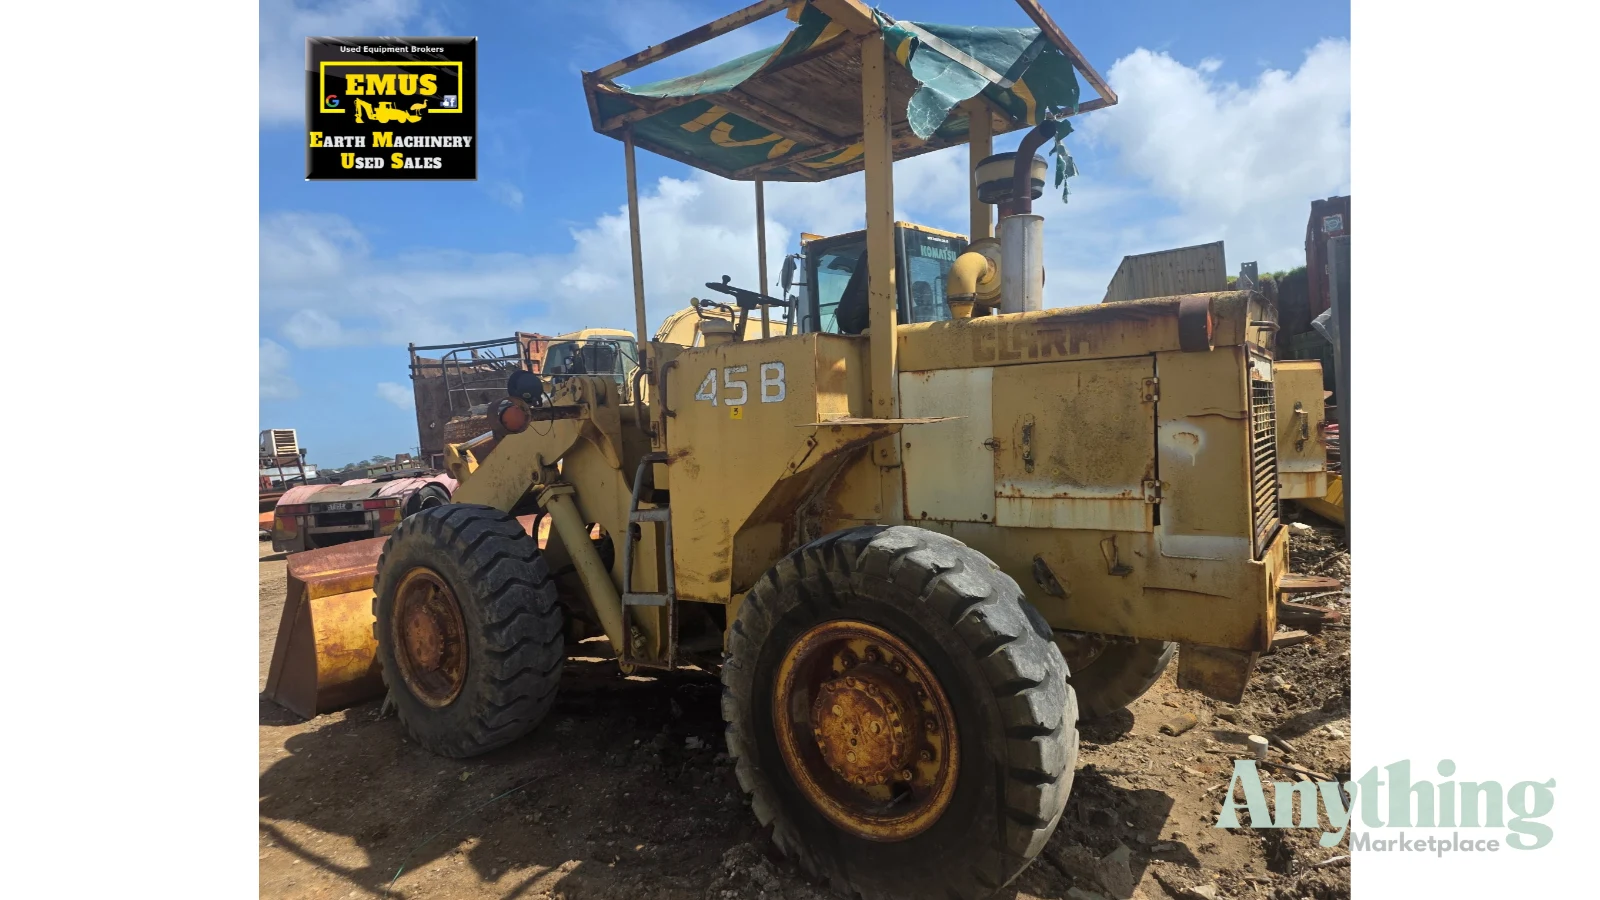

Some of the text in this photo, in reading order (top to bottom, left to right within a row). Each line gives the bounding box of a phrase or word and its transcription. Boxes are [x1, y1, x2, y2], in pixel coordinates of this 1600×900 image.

[920, 244, 957, 262] KOMATSU
[694, 360, 786, 407] 45 B
